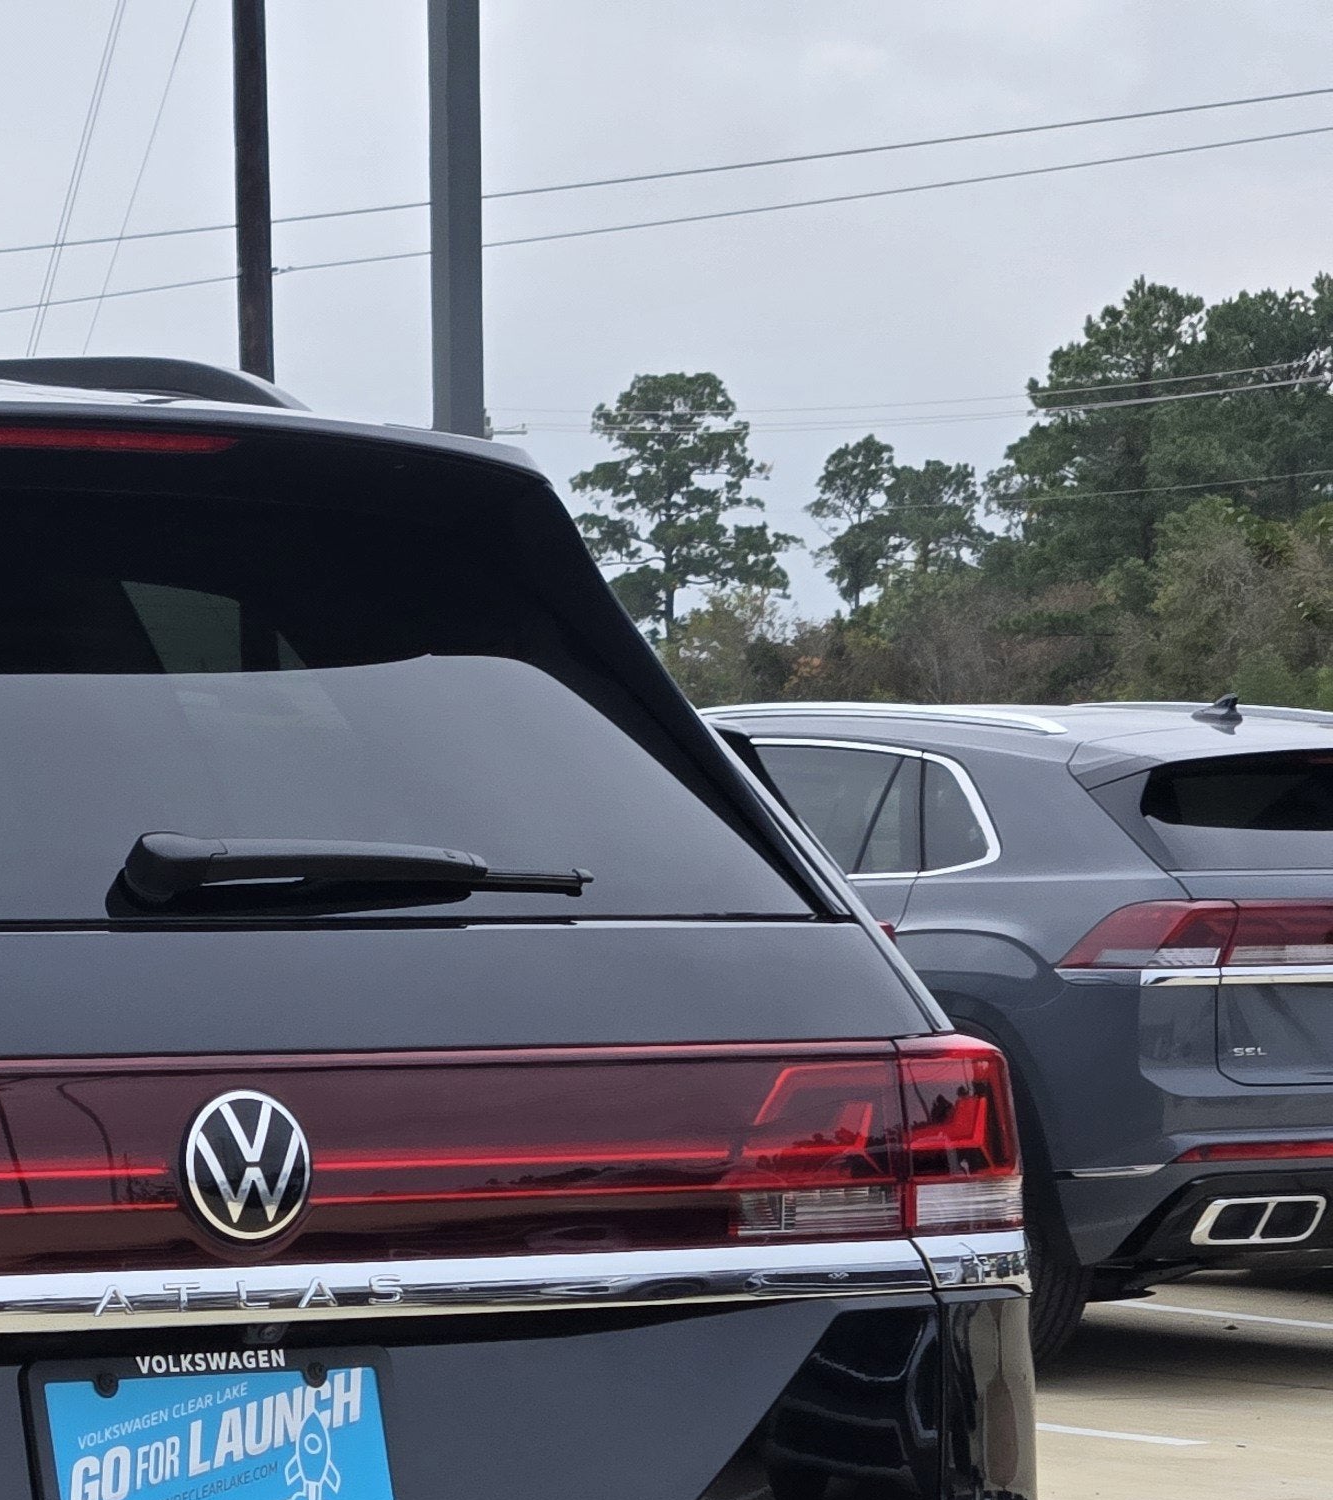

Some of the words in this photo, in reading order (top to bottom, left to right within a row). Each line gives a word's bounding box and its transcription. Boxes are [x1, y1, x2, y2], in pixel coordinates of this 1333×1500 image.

[1232, 1046, 1268, 1057] SEL
[93, 1273, 404, 1317] ATLAS
[135, 1348, 286, 1375] VOLKSWAGEN
[77, 1407, 169, 1450] VOLKSWAGEN
[172, 1394, 213, 1419] CLEAR
[216, 1381, 248, 1405] LAKE
[135, 1435, 181, 1491] FOR
[187, 1366, 363, 1478] LAUNCH
